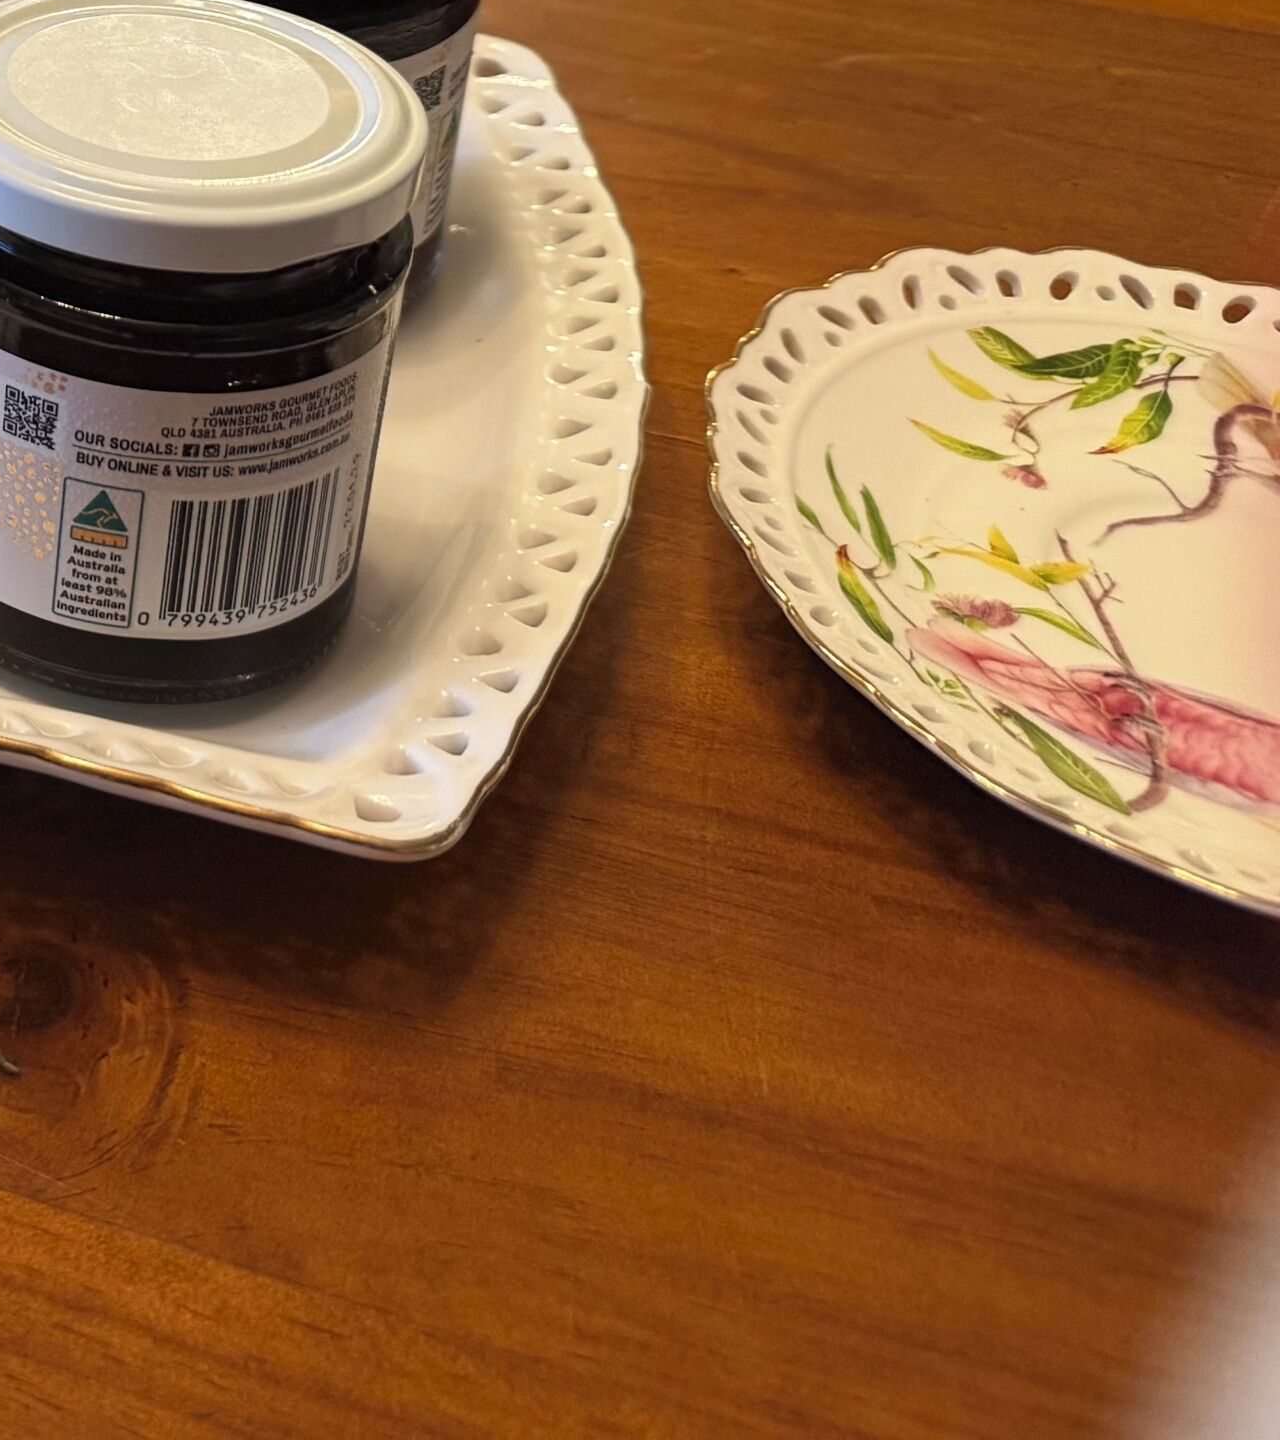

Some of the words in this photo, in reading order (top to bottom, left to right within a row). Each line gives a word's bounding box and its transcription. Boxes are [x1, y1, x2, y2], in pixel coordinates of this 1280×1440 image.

[209, 400, 277, 417] JAMWORKS
[278, 385, 328, 409] GOURMET
[191, 417, 199, 428] 7
[201, 413, 268, 429] TOWNSEND
[271, 405, 302, 422] ROAD,
[306, 397, 331, 413] GLEN
[73, 430, 106, 447] OUR
[109, 437, 179, 456] SOCIALS:
[160, 427, 186, 439] QLD
[75, 451, 105, 469] BUY
[107, 458, 160, 477] ONLINE
[161, 464, 172, 477] &
[175, 465, 210, 478] VISIT
[212, 465, 234, 478] US:
[73, 544, 107, 560] Made
[110, 551, 122, 562] in
[66, 555, 126, 575] Australia
[61, 577, 93, 593] least
[96, 585, 128, 600] 98%
[71, 568, 102, 583] from
[104, 576, 119, 586] at
[60, 590, 126, 610] Australian
[166, 608, 247, 628] 799439
[257, 582, 320, 620] 752436
